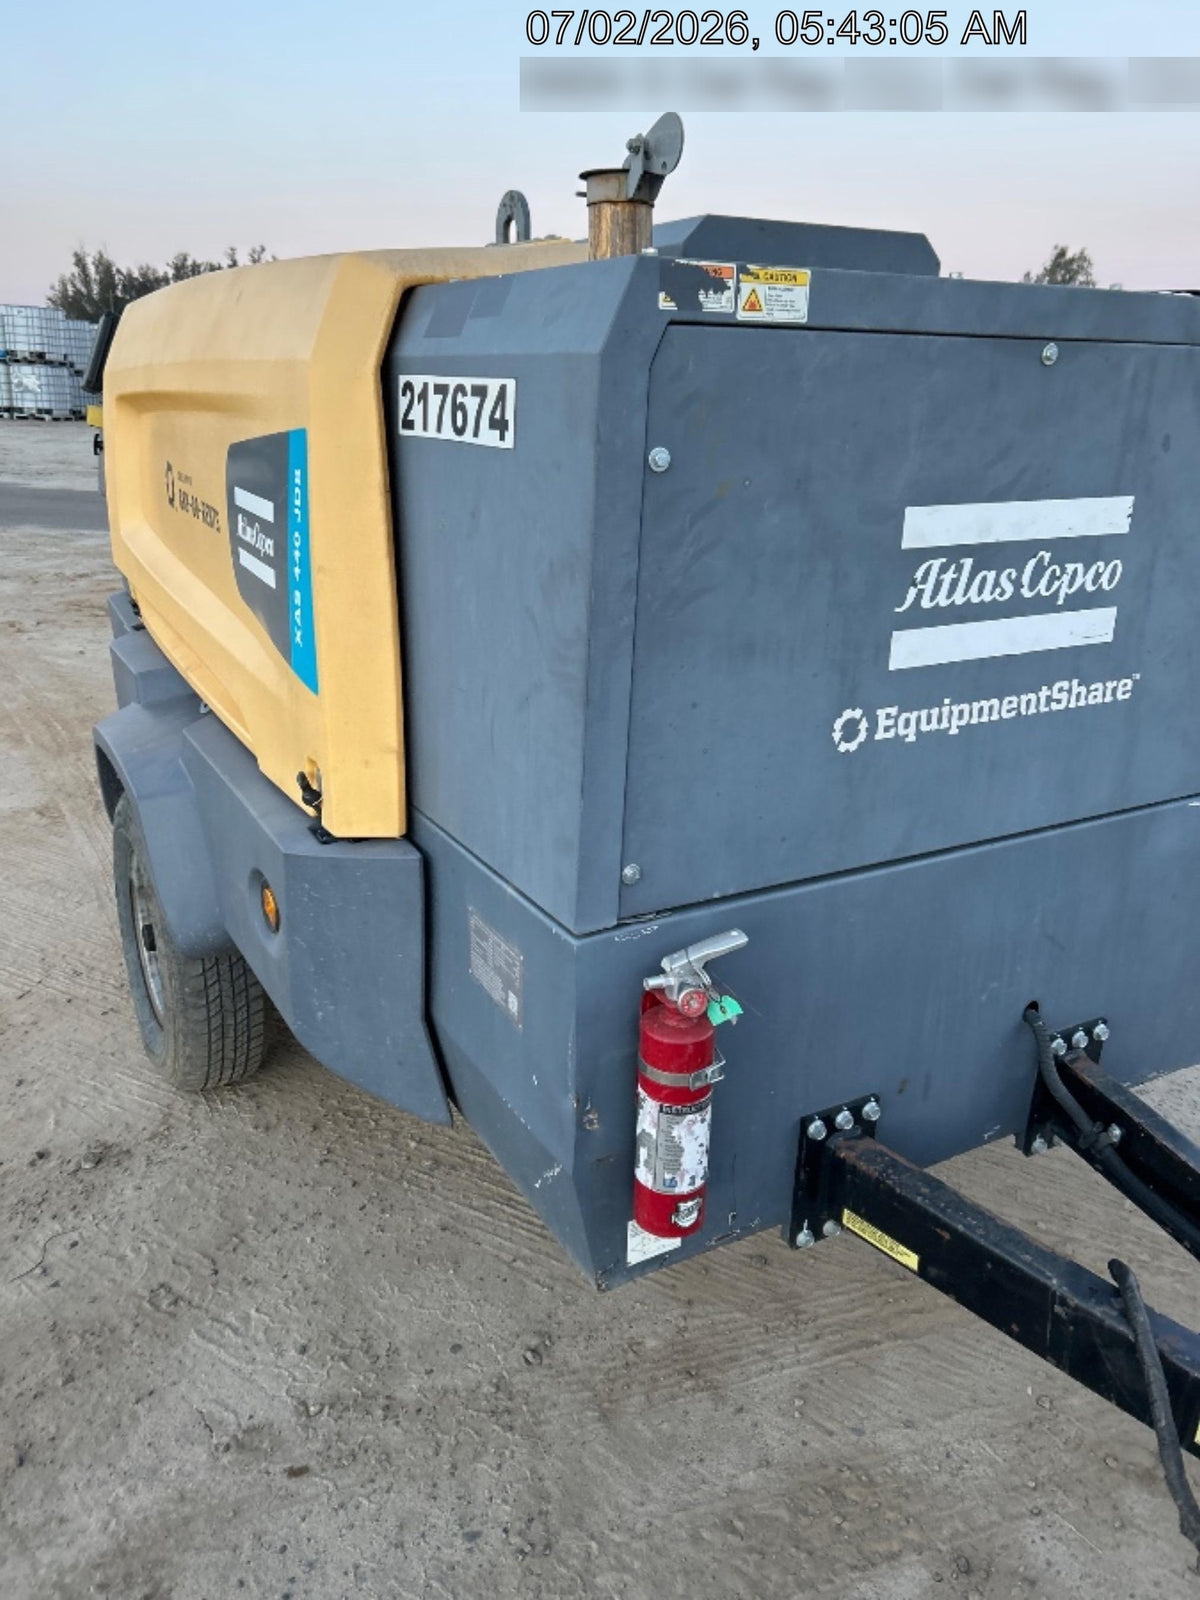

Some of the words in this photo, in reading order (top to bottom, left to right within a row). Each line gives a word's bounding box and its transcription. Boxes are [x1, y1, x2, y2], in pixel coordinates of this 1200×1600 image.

[401, 380, 509, 442] 217674
[293, 531, 302, 582] 440
[894, 557, 1016, 613] Atlas
[1019, 550, 1124, 606] Copco
